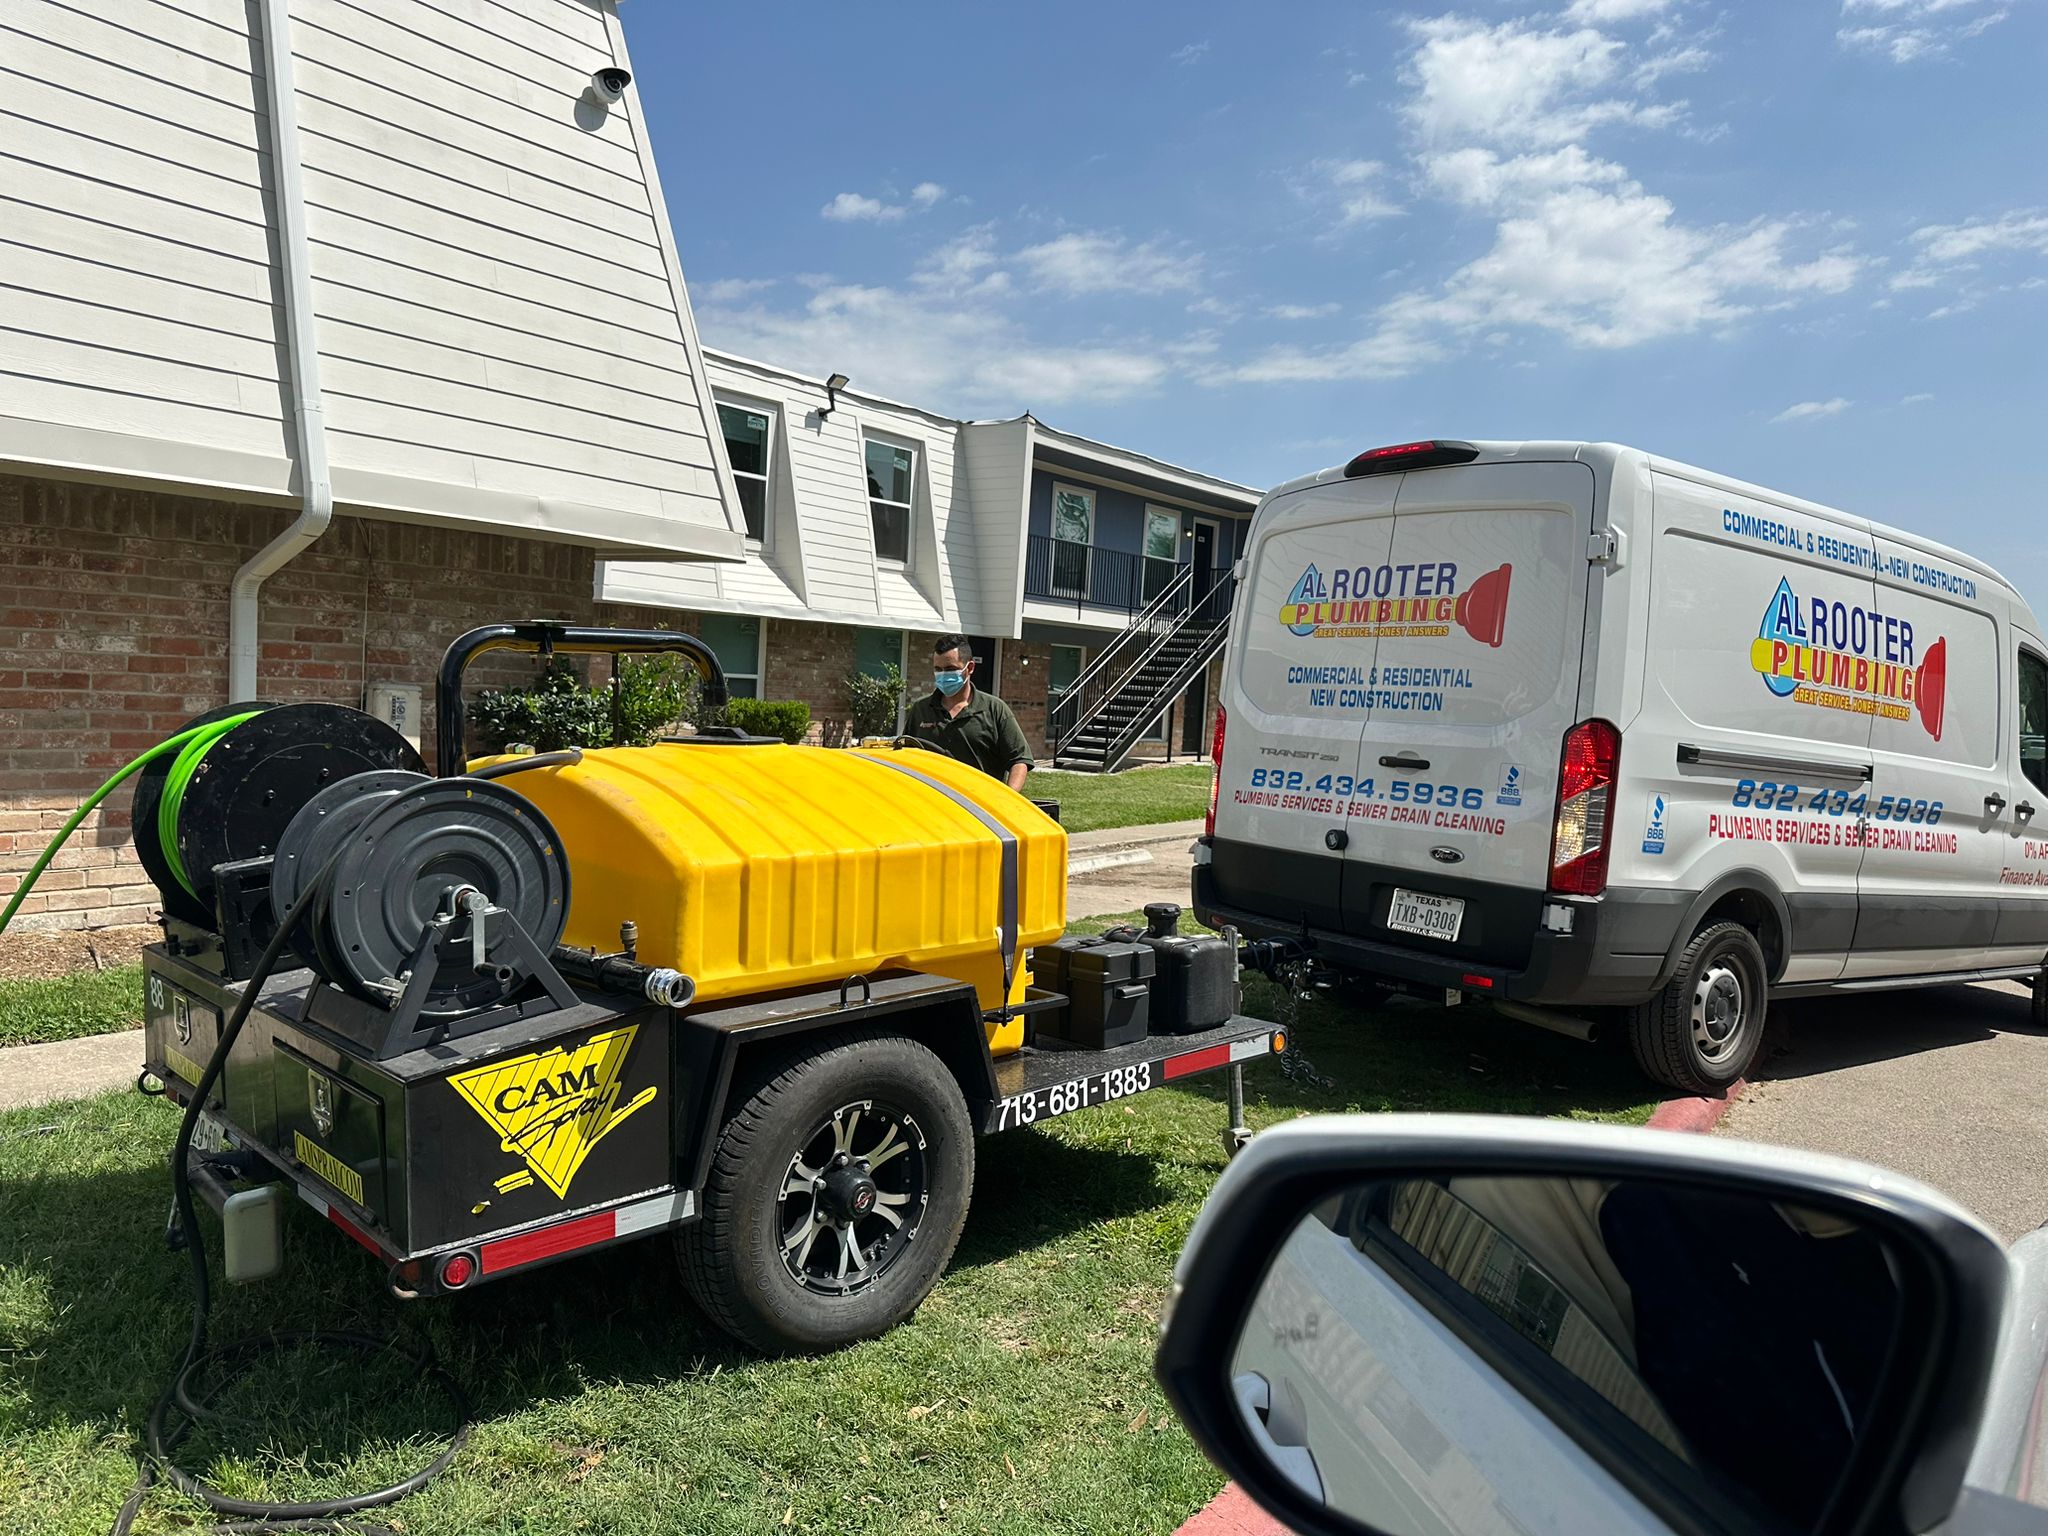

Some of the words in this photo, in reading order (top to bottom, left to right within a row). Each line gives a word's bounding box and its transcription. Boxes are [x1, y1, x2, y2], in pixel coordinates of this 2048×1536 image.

[1723, 509, 1803, 550] COMMERCIAL
[1807, 532, 1814, 553] &
[1912, 563, 1977, 600] CONSTRUCTION
[1300, 573, 1327, 598] AL
[1332, 562, 1457, 599] ROOTER
[1295, 597, 1454, 626] PLUMBING
[1314, 627, 1336, 637] GREAT
[1373, 626, 1407, 636] HONEST
[1407, 625, 1449, 636] ANSWERS
[1776, 593, 1807, 637] AL
[1811, 597, 1914, 666] ROOTER
[1288, 667, 1364, 685] COMMERCIAL
[1369, 667, 1377, 685] &
[1382, 668, 1473, 688] RESIDENTIAL
[1771, 639, 1914, 703] PLUMBING
[1310, 689, 1337, 707] NEW
[1339, 689, 1443, 711] CONSTRUCTION
[1794, 688, 1819, 704] GREAT
[1852, 697, 1880, 715] HONEST
[1879, 702, 1910, 720] ANSWERS
[1260, 747, 1319, 759] TRANSIT
[1251, 768, 1484, 811] 832.434.5936
[1732, 779, 1944, 825] 832.434.5936
[1234, 789, 1278, 807] PLUMBING
[1281, 796, 1333, 814] SERVICES
[1335, 802, 1343, 815] &
[1347, 802, 1388, 820] SEWER
[1390, 808, 1431, 826] DRAIN
[1434, 811, 1506, 836] CLEANING
[1709, 814, 1772, 841] PLUMBING
[1776, 819, 1831, 845] SERVICES
[1834, 824, 1842, 845] &
[1882, 827, 1912, 851] DRAIN
[1914, 831, 1957, 854] CLEANING
[2025, 841, 2037, 859] 0%
[1999, 867, 2034, 886] Finance
[1415, 896, 1442, 907] TEXAS
[151, 977, 164, 1010] 88
[494, 1063, 600, 1114] CAM
[996, 1062, 1151, 1132] 713-681-1383
